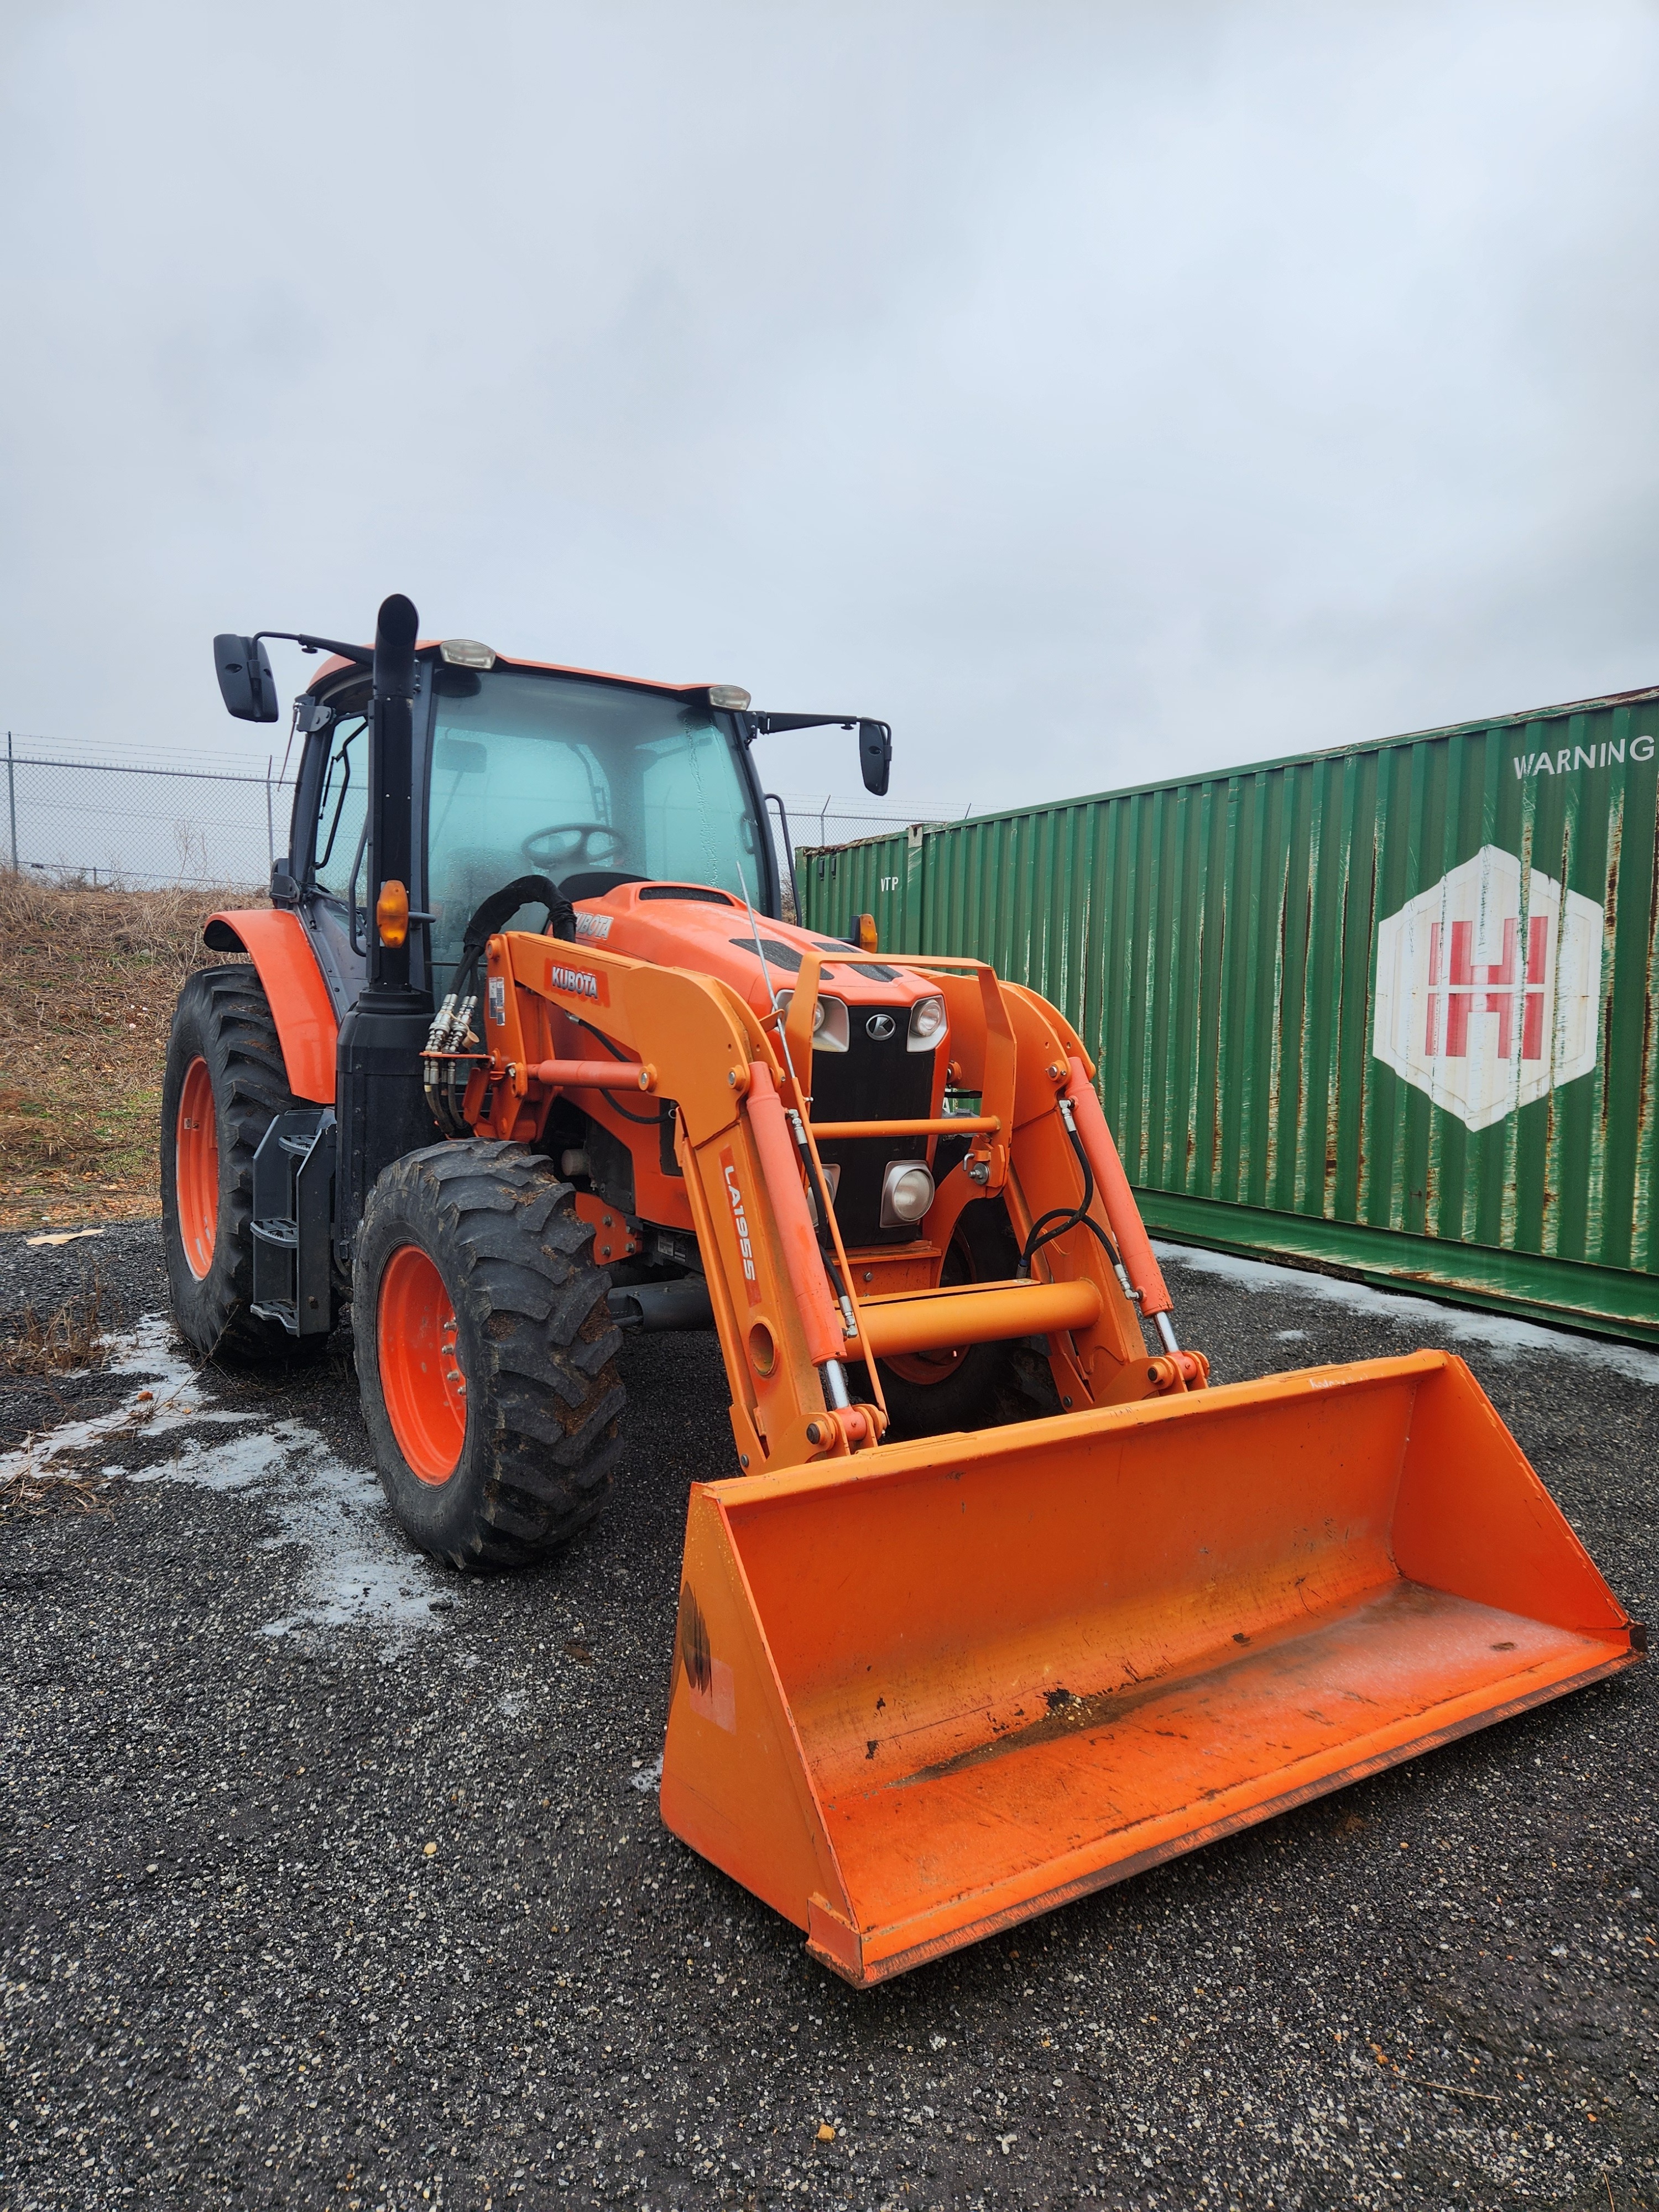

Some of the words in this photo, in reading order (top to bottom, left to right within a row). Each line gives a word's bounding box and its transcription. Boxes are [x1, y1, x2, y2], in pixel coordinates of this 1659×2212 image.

[1513, 735, 1655, 780] WARNING
[880, 877, 899, 891] VTP
[575, 912, 614, 939] UBOTA
[552, 966, 598, 999] KUBOTA
[725, 1166, 755, 1281] LA1955
